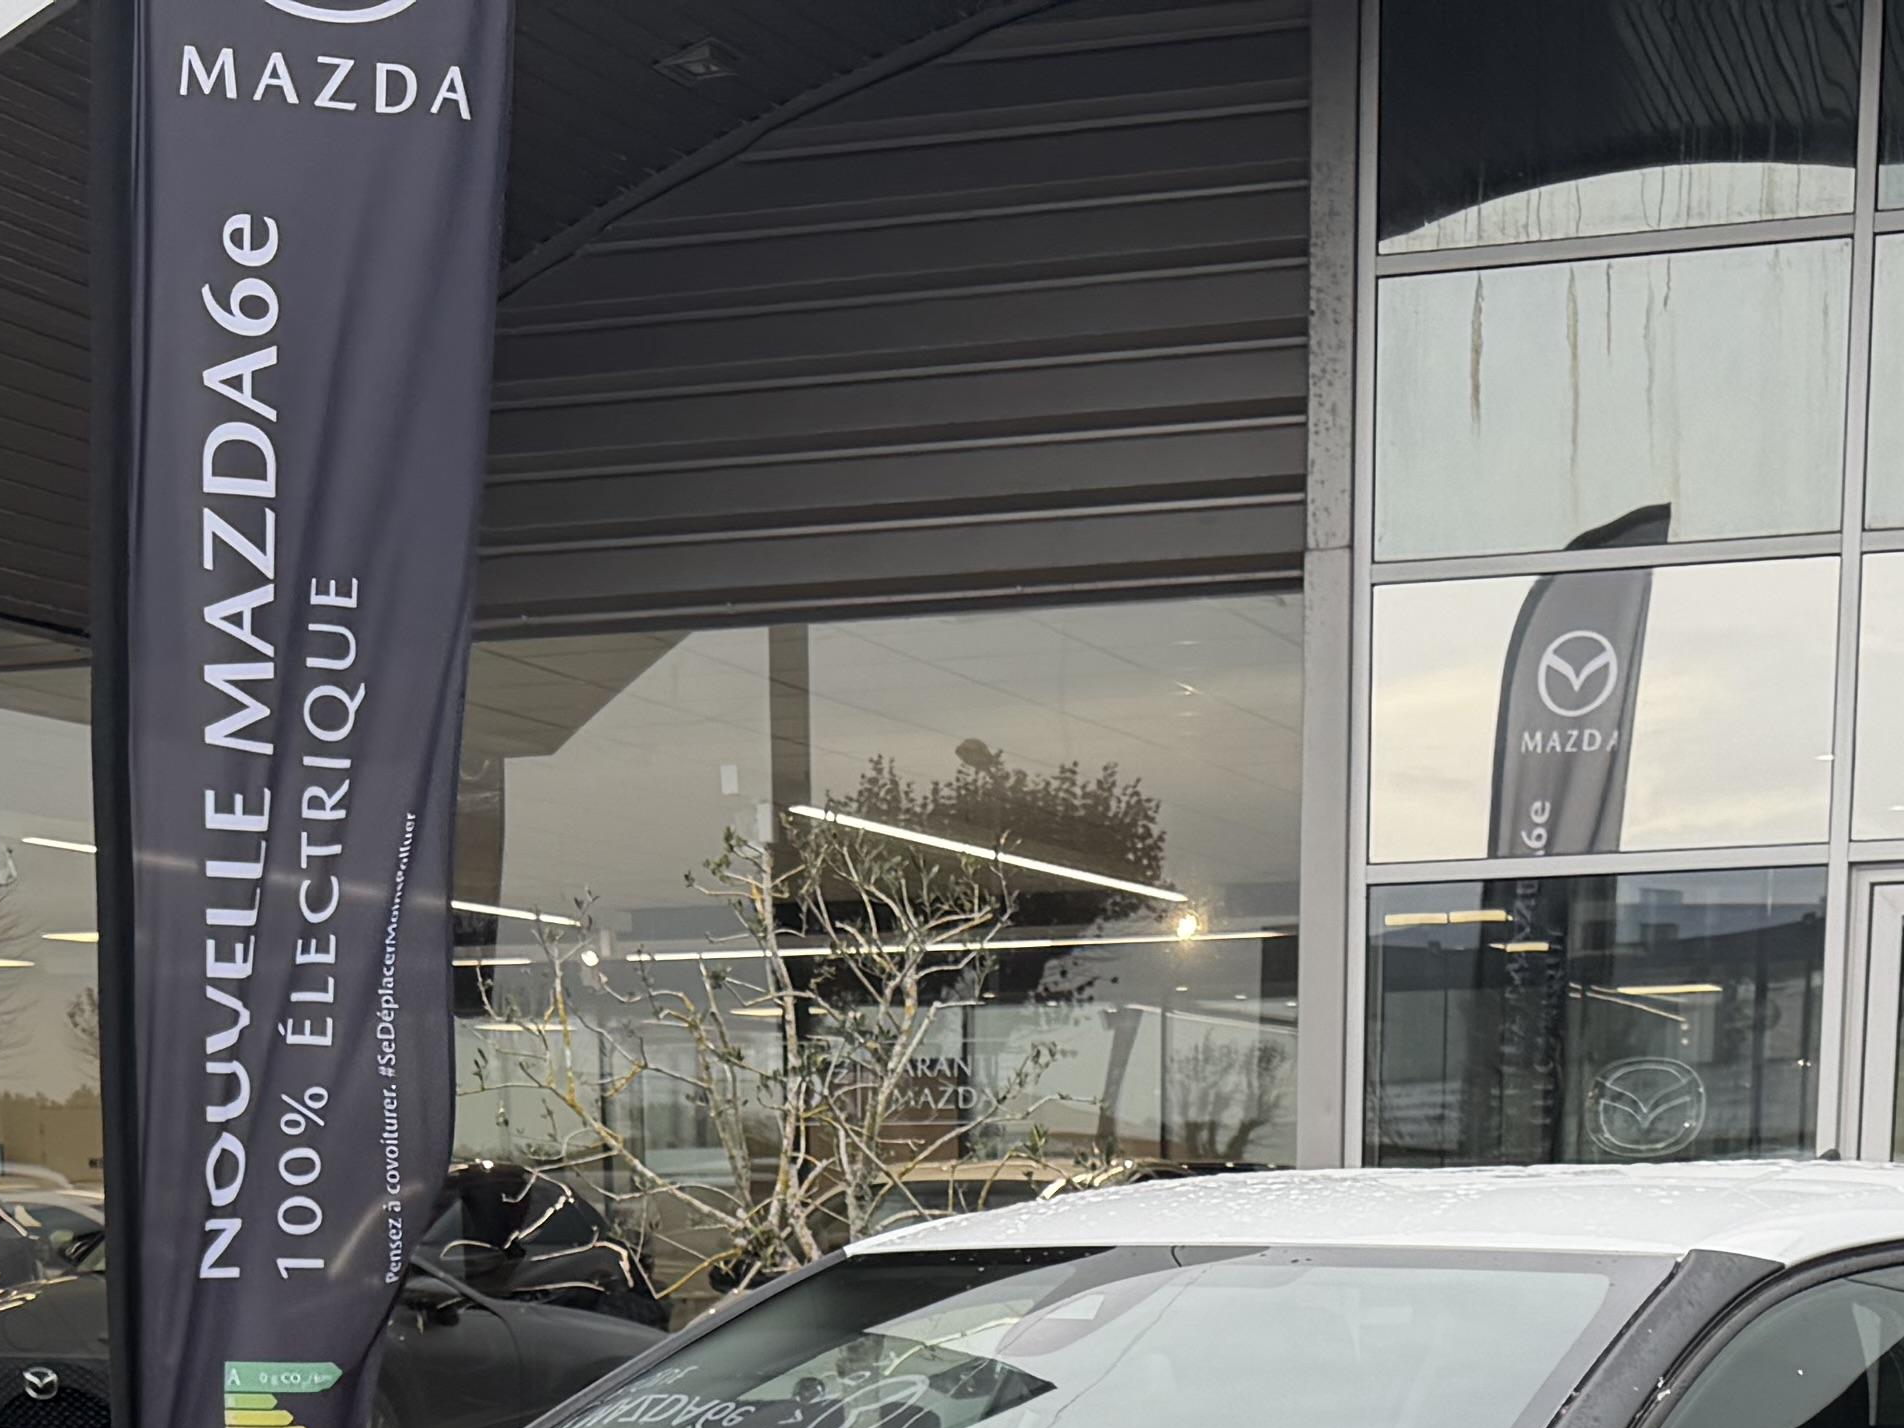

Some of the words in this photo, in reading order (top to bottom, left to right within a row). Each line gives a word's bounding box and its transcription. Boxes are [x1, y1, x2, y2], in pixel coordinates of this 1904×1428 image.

[179, 44, 473, 121] MAZDA
[203, 213, 281, 756] MAZDA6e
[277, 576, 367, 1047] ÉLECTRIQUE
[1520, 728, 1619, 754] MAZDA
[199, 788, 271, 1280] NOUVELLE
[276, 1085, 330, 1281] 100%
[380, 1083, 401, 1195] covoiturer.
[385, 1217, 403, 1285] Pensez
